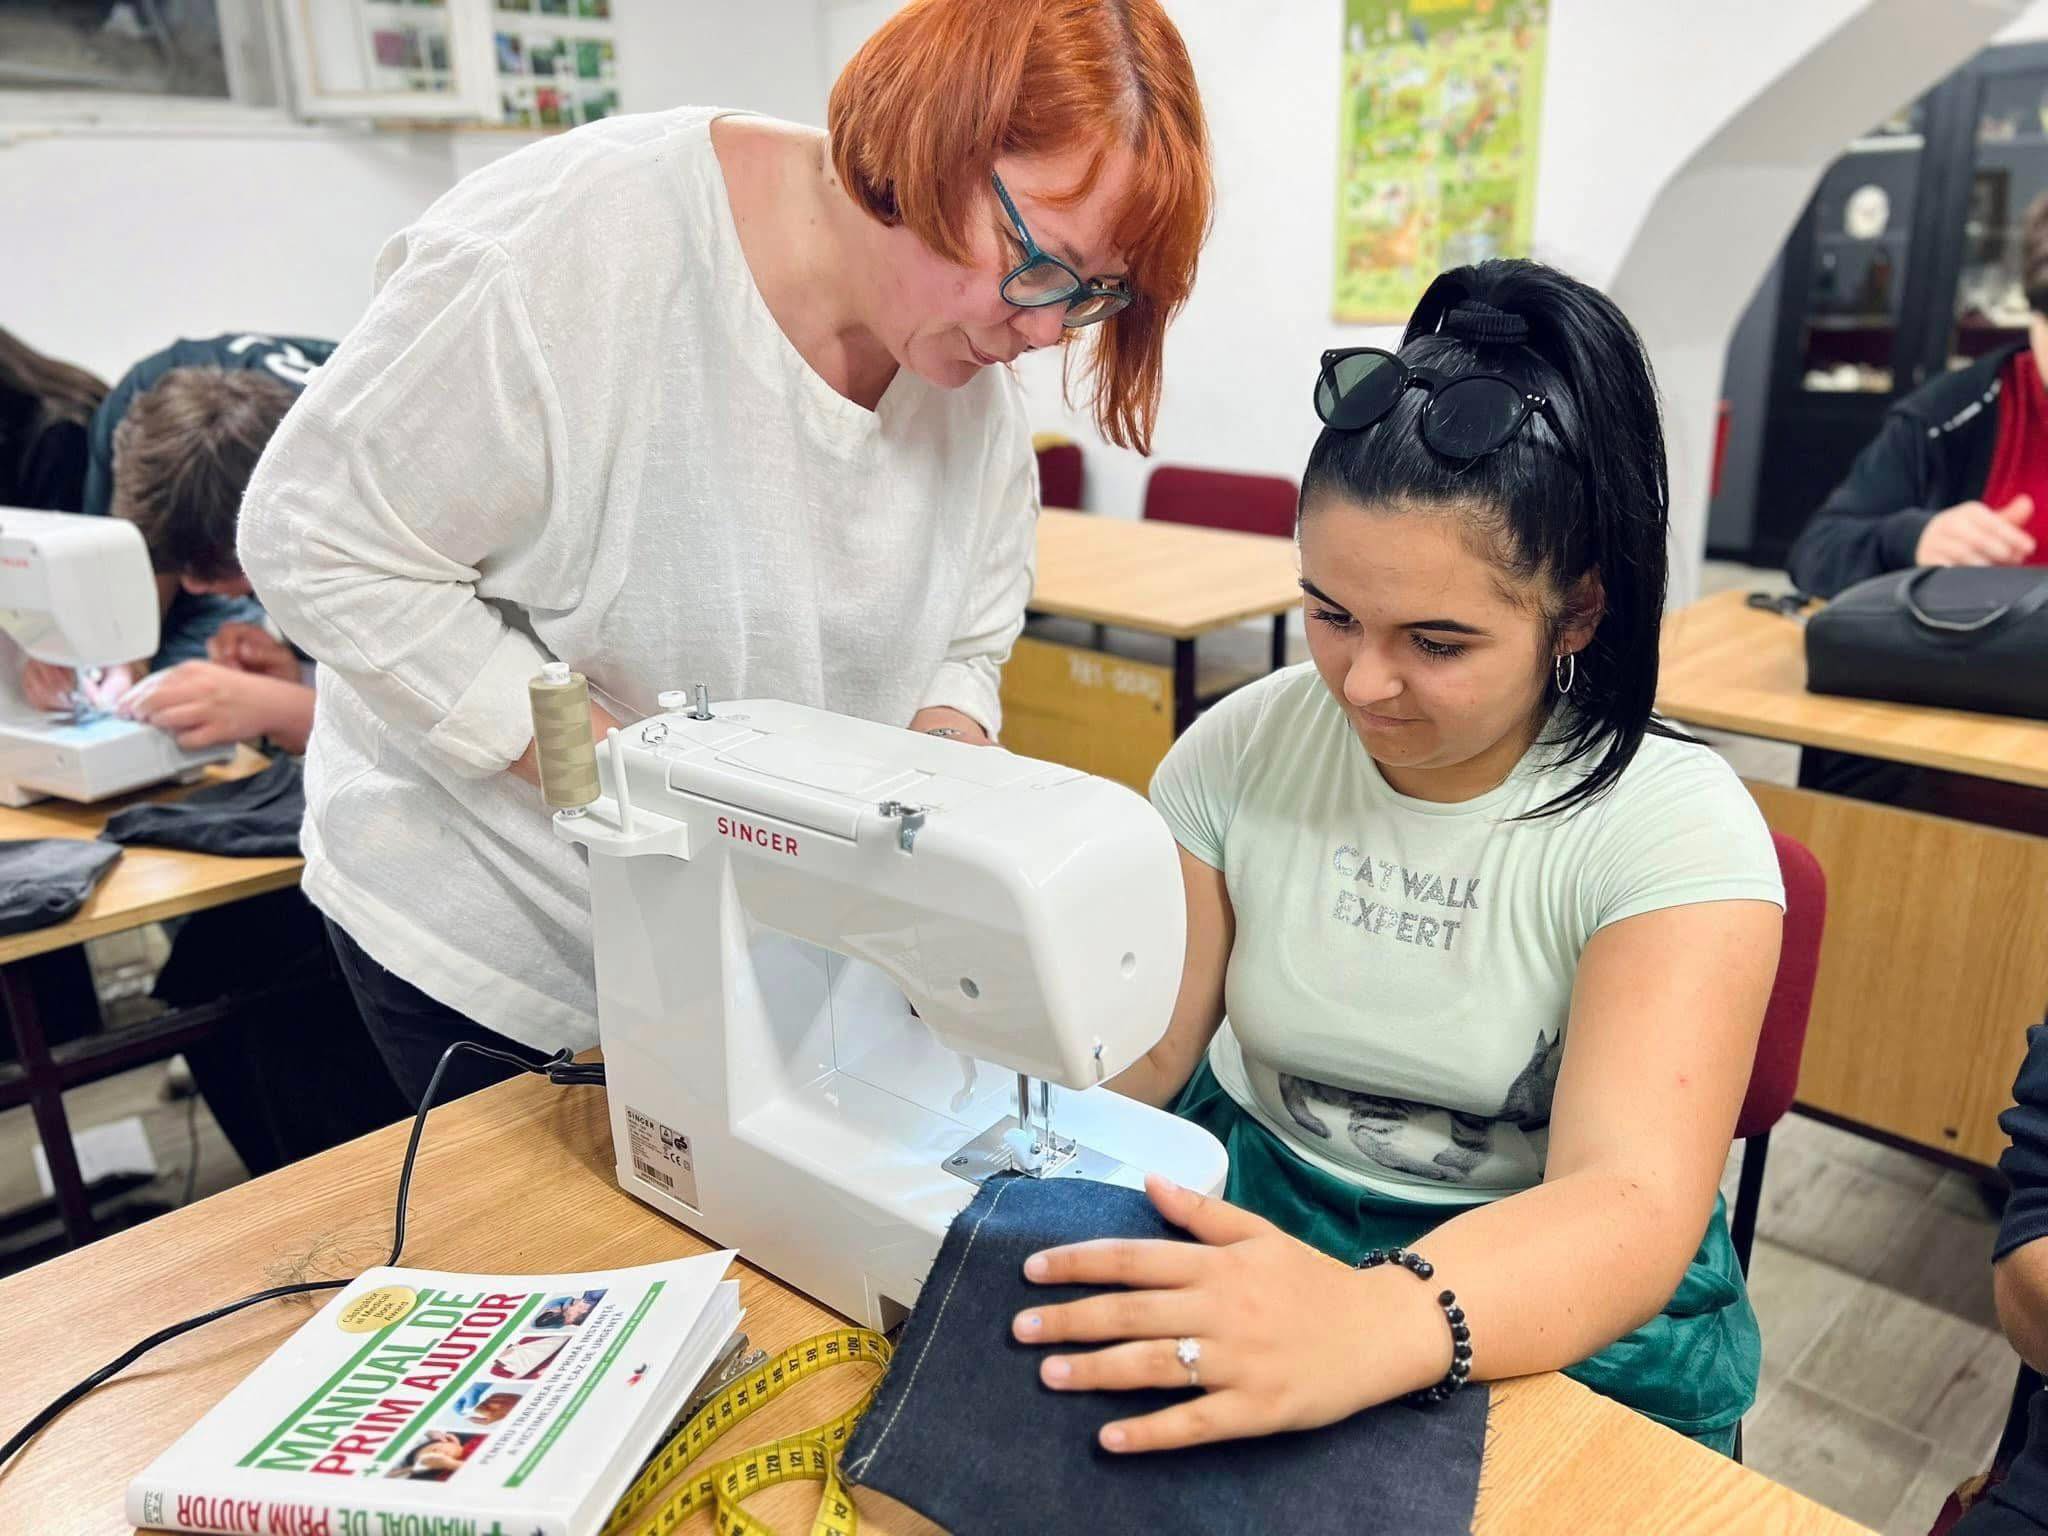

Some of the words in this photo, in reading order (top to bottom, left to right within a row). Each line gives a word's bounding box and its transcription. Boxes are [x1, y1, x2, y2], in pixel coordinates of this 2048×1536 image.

[716, 816, 798, 857] SINGER
[1333, 889, 1462, 951] EXPERT
[627, 1110, 654, 1129] SINGER
[825, 1341, 838, 1355] 99
[847, 1336, 859, 1352] 100
[789, 1358, 800, 1373] 97
[806, 1348, 817, 1363] 98
[256, 1343, 438, 1472] MANUAL
[406, 1290, 487, 1329] DE
[309, 1398, 425, 1476] PRIM
[400, 1292, 529, 1392] AJUTOR
[755, 1379, 767, 1396] 95
[736, 1390, 749, 1407] 94
[765, 1454, 781, 1474] 120
[789, 1450, 803, 1470] 121
[812, 1449, 825, 1470] 122
[176, 1493, 263, 1534] AJUTOR
[268, 1502, 331, 1536] PRIM
[337, 1508, 368, 1536] DE
